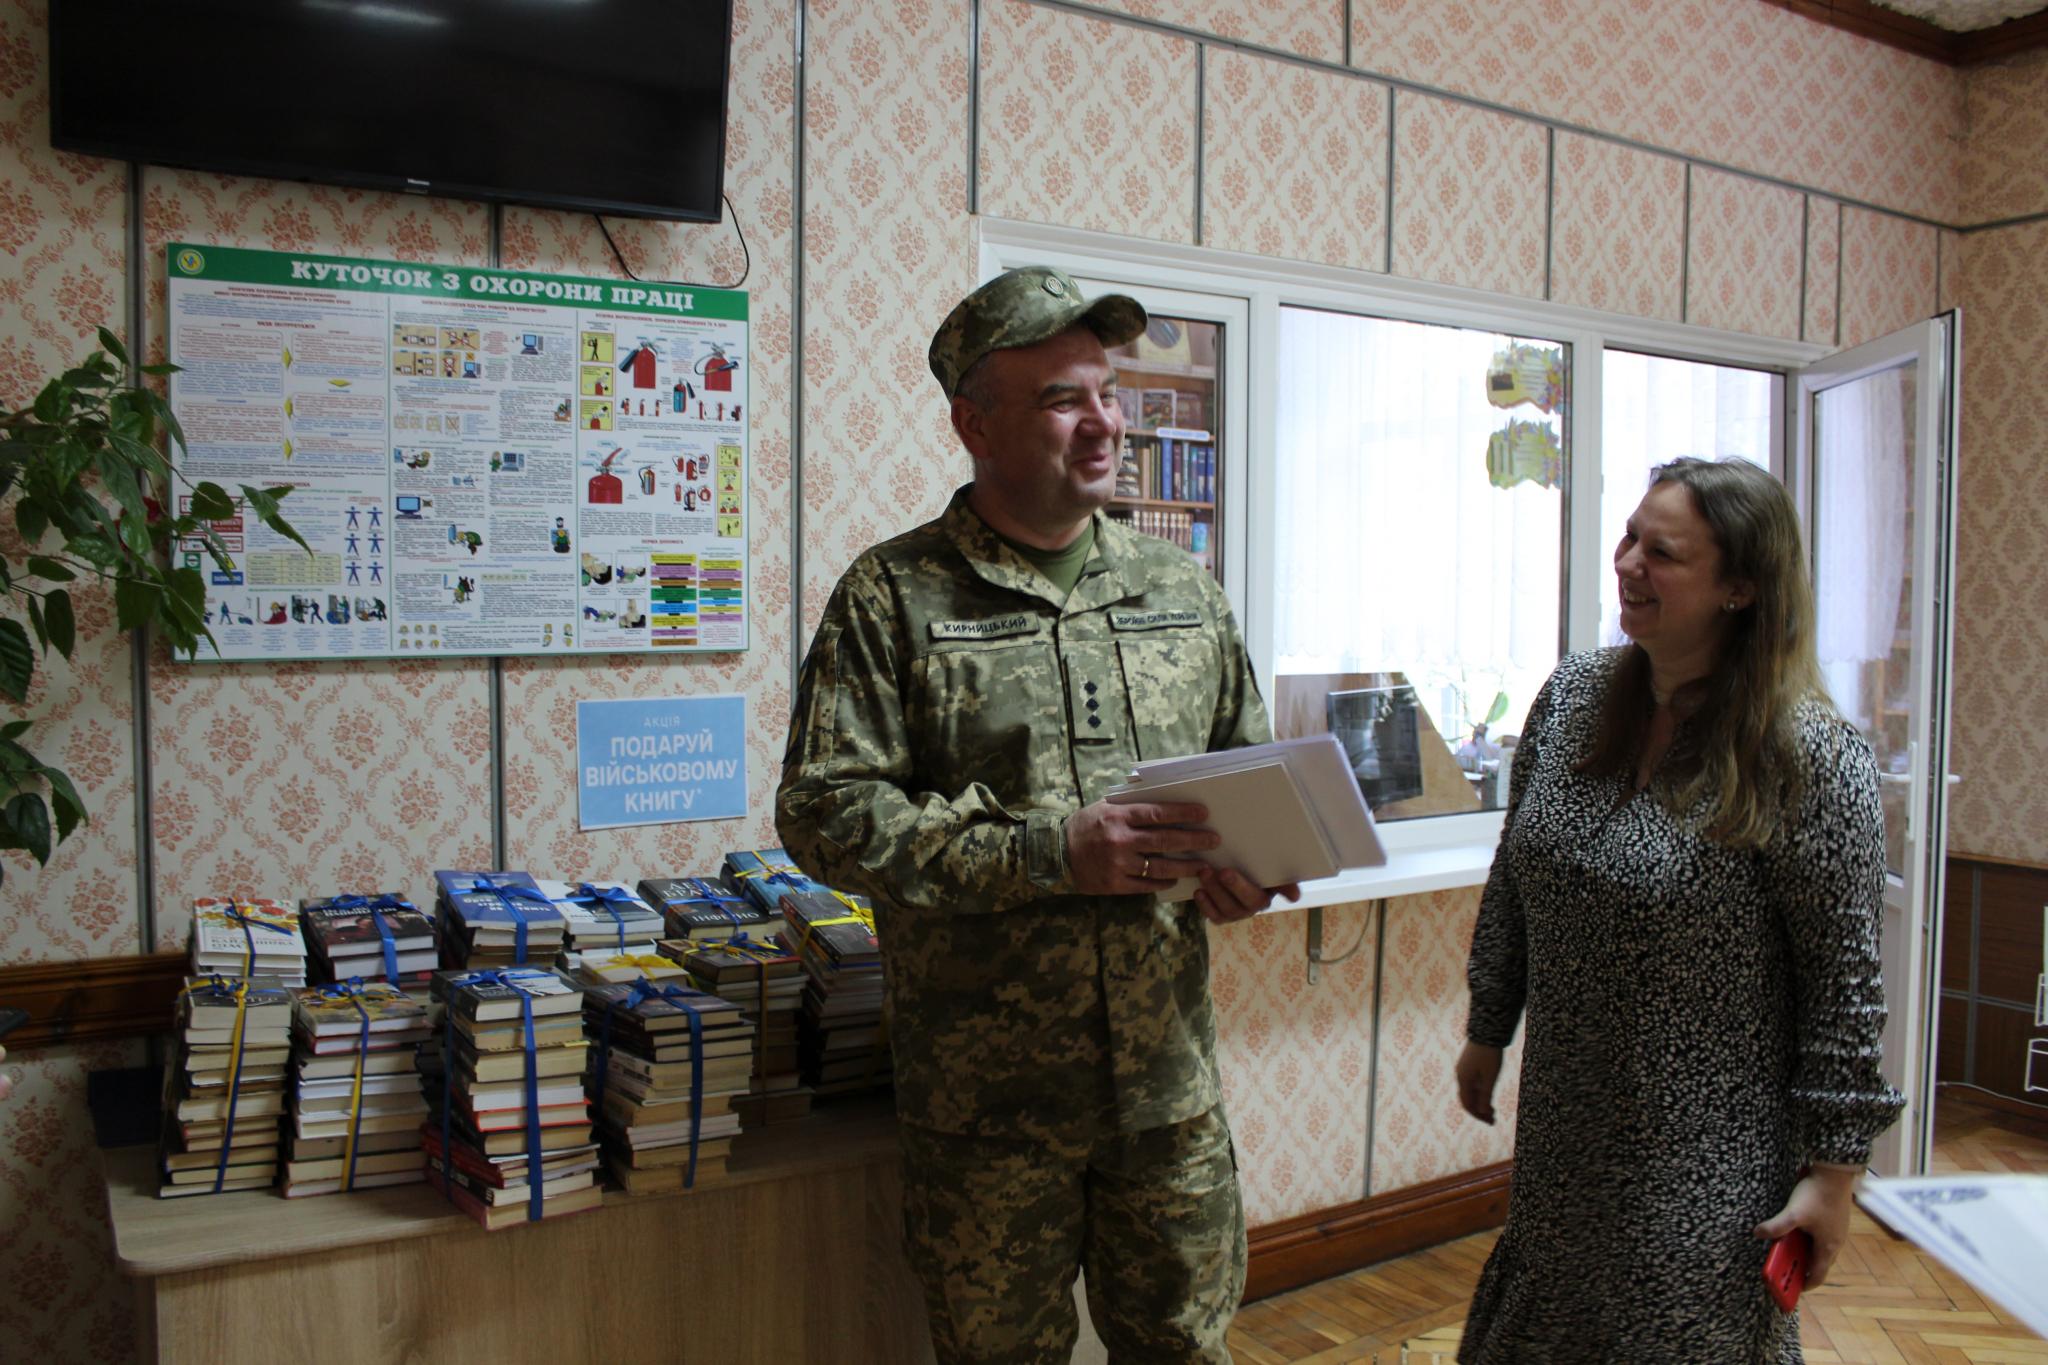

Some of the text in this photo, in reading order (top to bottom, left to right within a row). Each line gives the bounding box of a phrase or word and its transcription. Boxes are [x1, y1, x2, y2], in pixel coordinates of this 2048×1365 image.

[290, 260, 694, 312] КУТОЧОК З ОХОРОНИ ПРАЦІ
[943, 616, 1028, 633] КИРНИЦЬКИЙ
[643, 716, 681, 728] АКЦІЯ
[610, 728, 714, 760] ПОДАРУЙ
[585, 759, 738, 788] ВІЙСЬКОВОМУ
[663, 886, 732, 898] БРАН
[691, 911, 760, 922] ІНФЕНО
